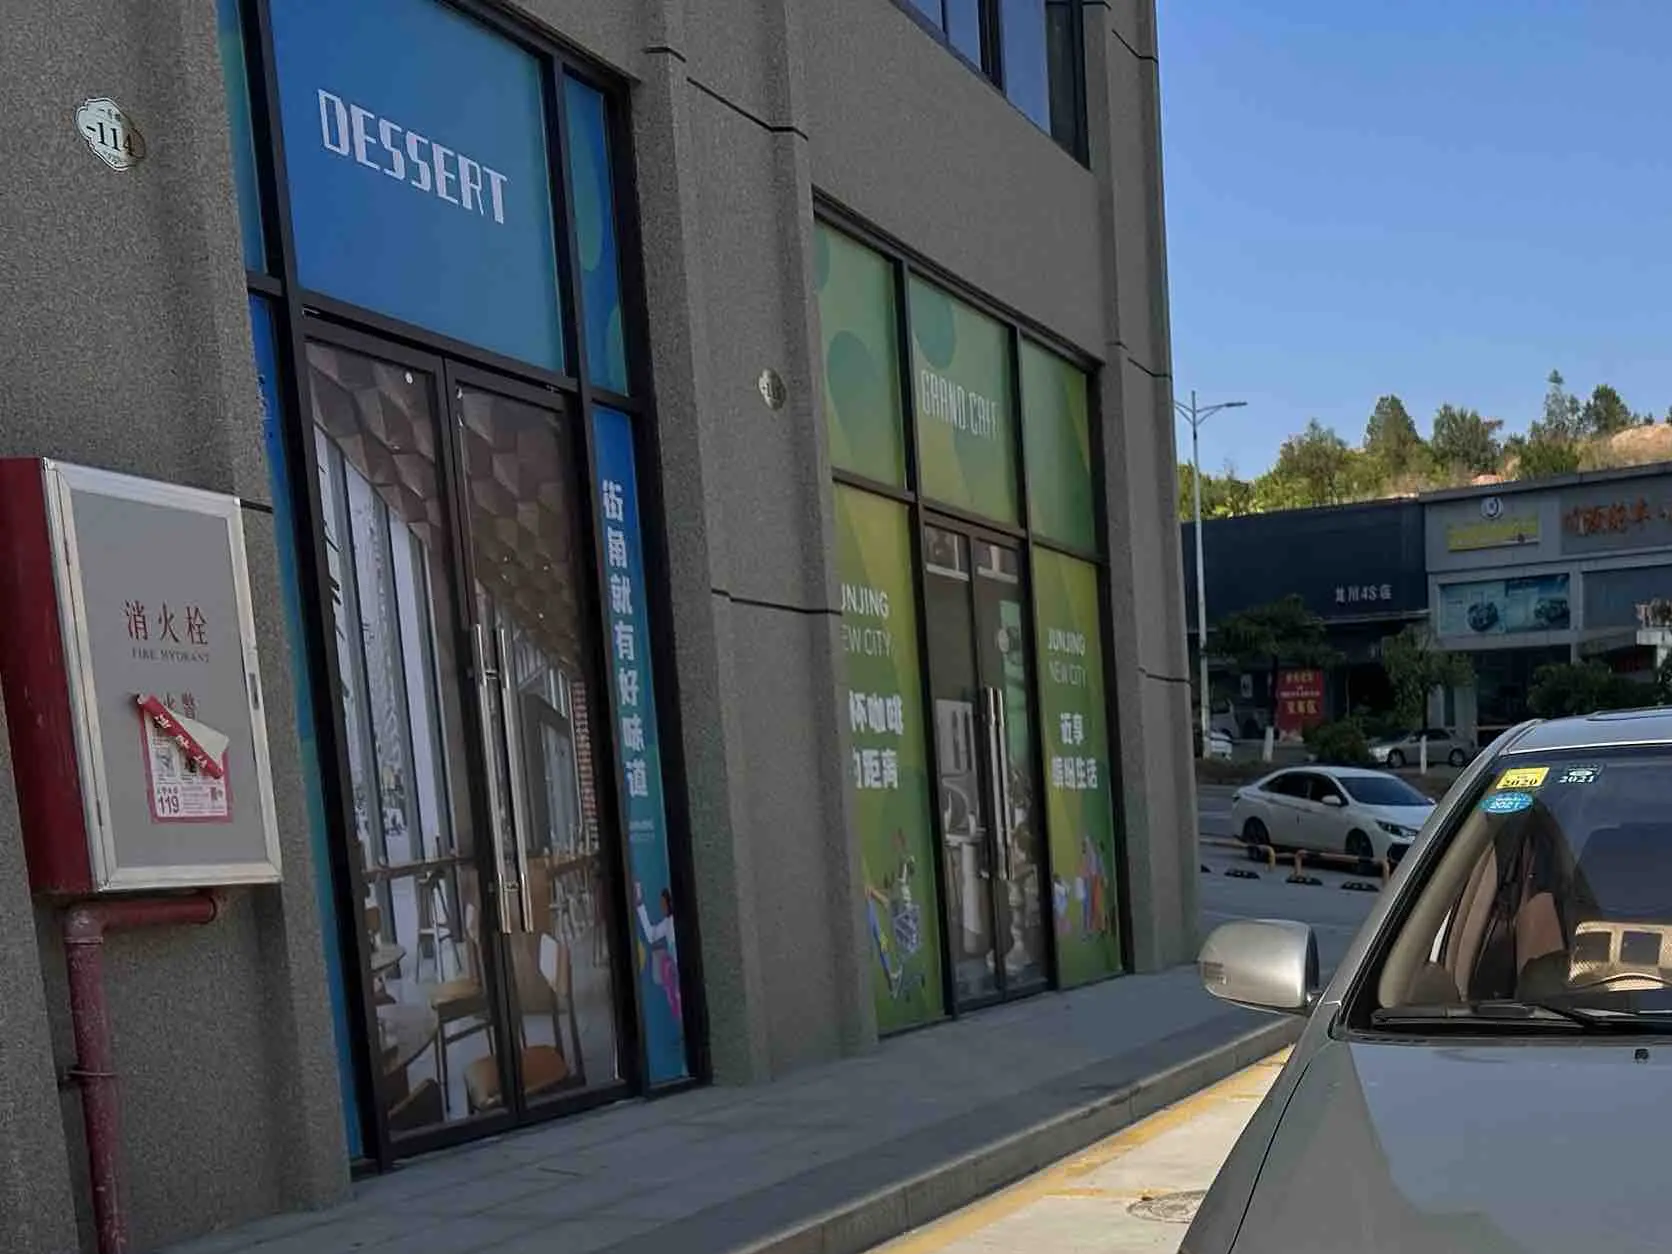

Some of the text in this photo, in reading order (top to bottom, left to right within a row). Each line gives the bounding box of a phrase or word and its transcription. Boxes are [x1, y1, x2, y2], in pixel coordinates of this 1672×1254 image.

[317, 88, 508, 224] DESSERT
[920, 368, 967, 431] GRAND
[125, 599, 209, 646] 消火栓
[601, 478, 650, 798] 街角就有好味道
[157, 794, 180, 815] 119
